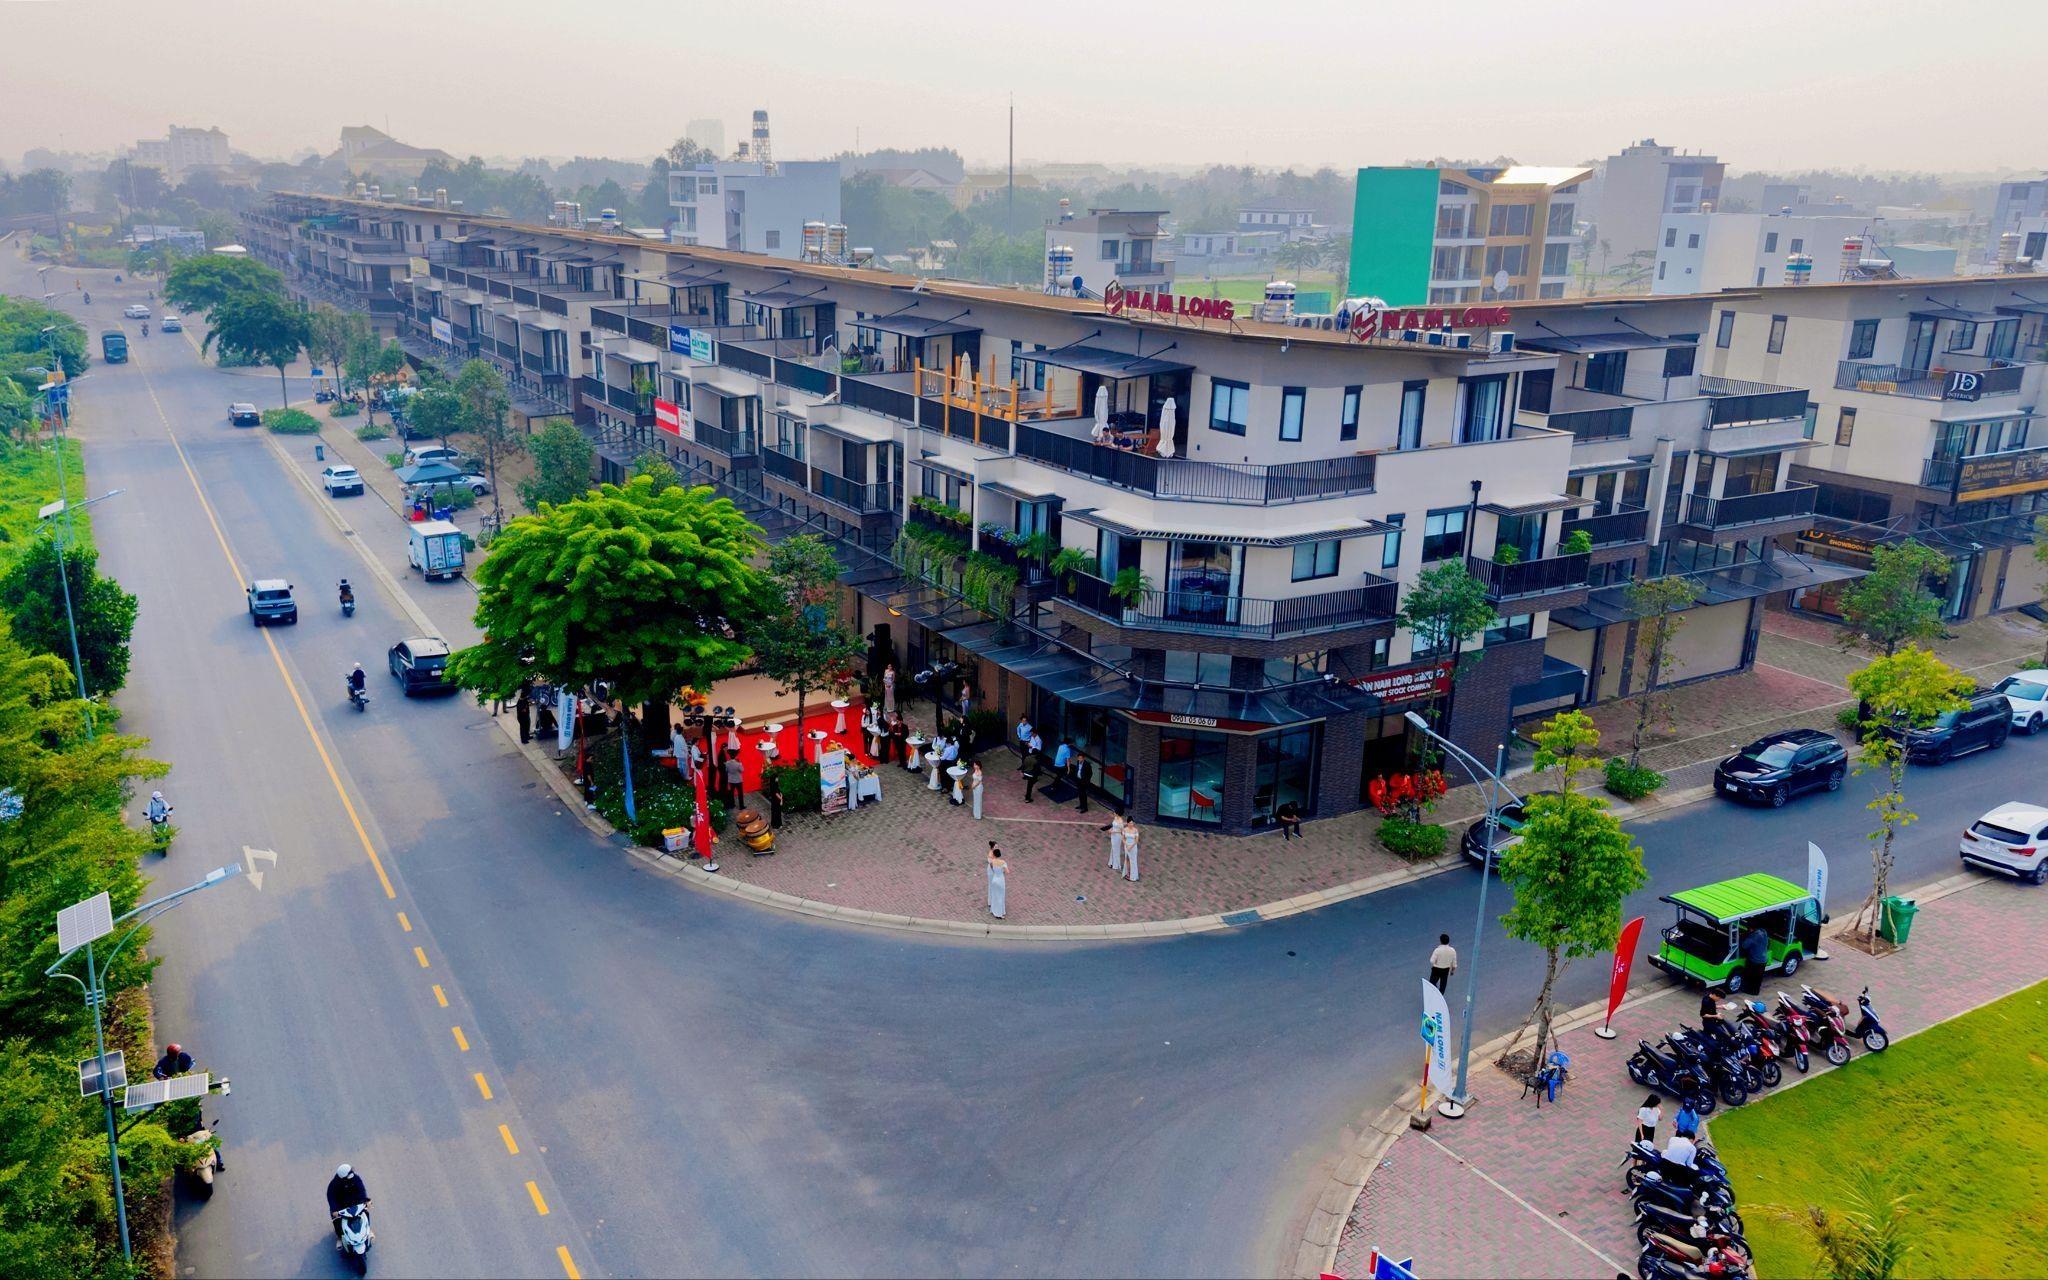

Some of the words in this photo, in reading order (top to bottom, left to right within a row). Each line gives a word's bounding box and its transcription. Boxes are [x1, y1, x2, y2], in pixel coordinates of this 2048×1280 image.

[1126, 290, 1174, 313] NAM
[1179, 295, 1235, 321] LONG
[1382, 308, 1443, 331] NAM
[1450, 306, 1512, 328] LONG
[1950, 372, 1977, 391] JD
[1828, 539, 1866, 552] SHOWROOM
[1374, 678, 1391, 691] NAM
[1392, 674, 1413, 687] LONG
[1388, 686, 1406, 695] STOCK
[1406, 682, 1432, 692] COMPAN
[1437, 1036, 1445, 1060] LONG
